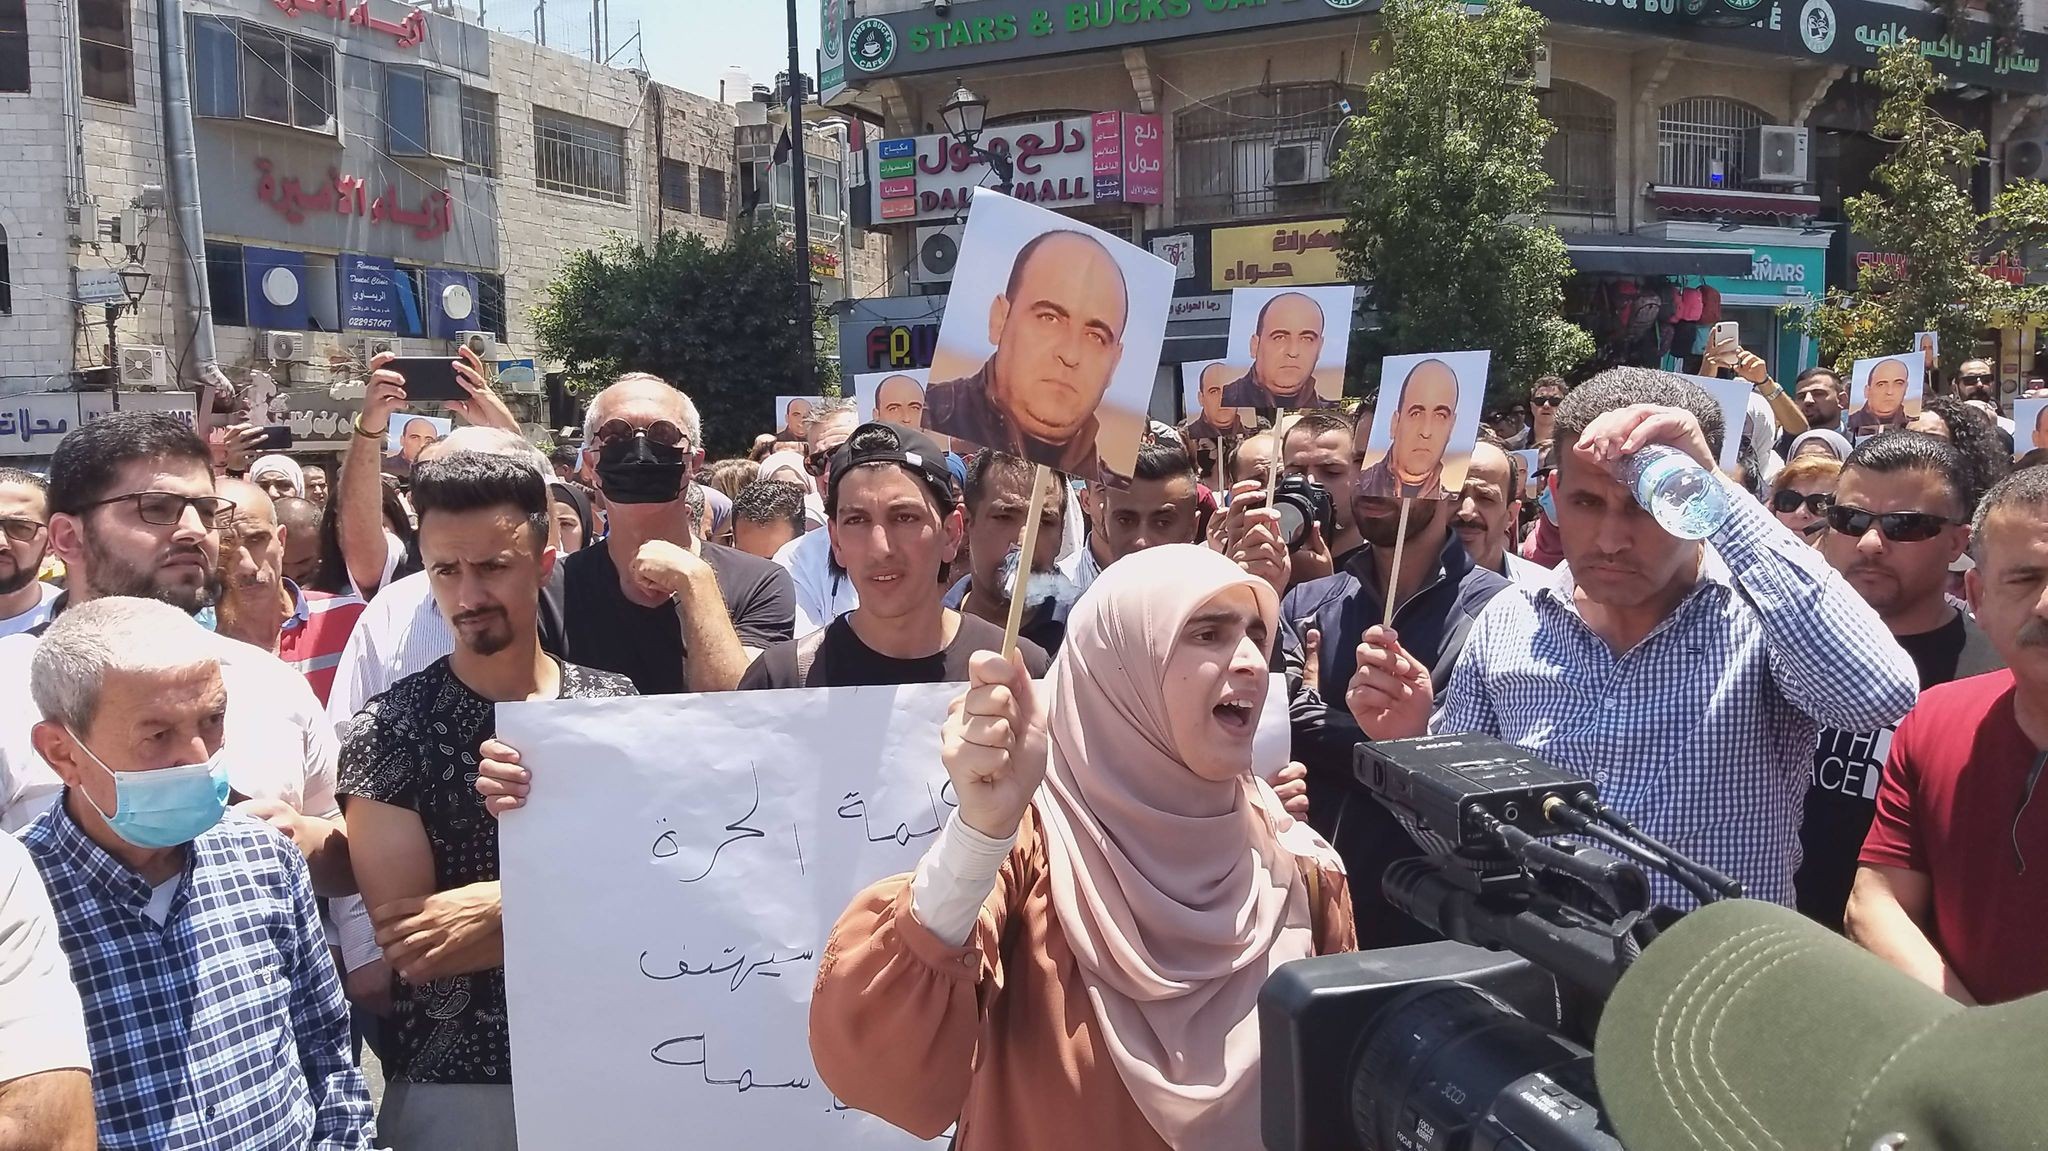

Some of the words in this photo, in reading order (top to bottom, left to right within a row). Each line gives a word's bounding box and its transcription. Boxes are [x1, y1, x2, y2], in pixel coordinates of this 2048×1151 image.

[850, 23, 867, 49] STARS
[908, 14, 1017, 51] STARS
[1027, 8, 1053, 38] &
[1065, 0, 1191, 32] BUCKS
[859, 56, 884, 68] CAFE
[1134, 122, 1158, 147] دلع
[1016, 120, 1085, 175] دلع
[1128, 153, 1160, 173] مول
[1014, 176, 1089, 203] MALL
[1223, 260, 1294, 284] حواء
[348, 317, 392, 328] 022957047
[651, 759, 805, 884] الحرة
[1418, 1119, 1435, 1136] FOCUS
